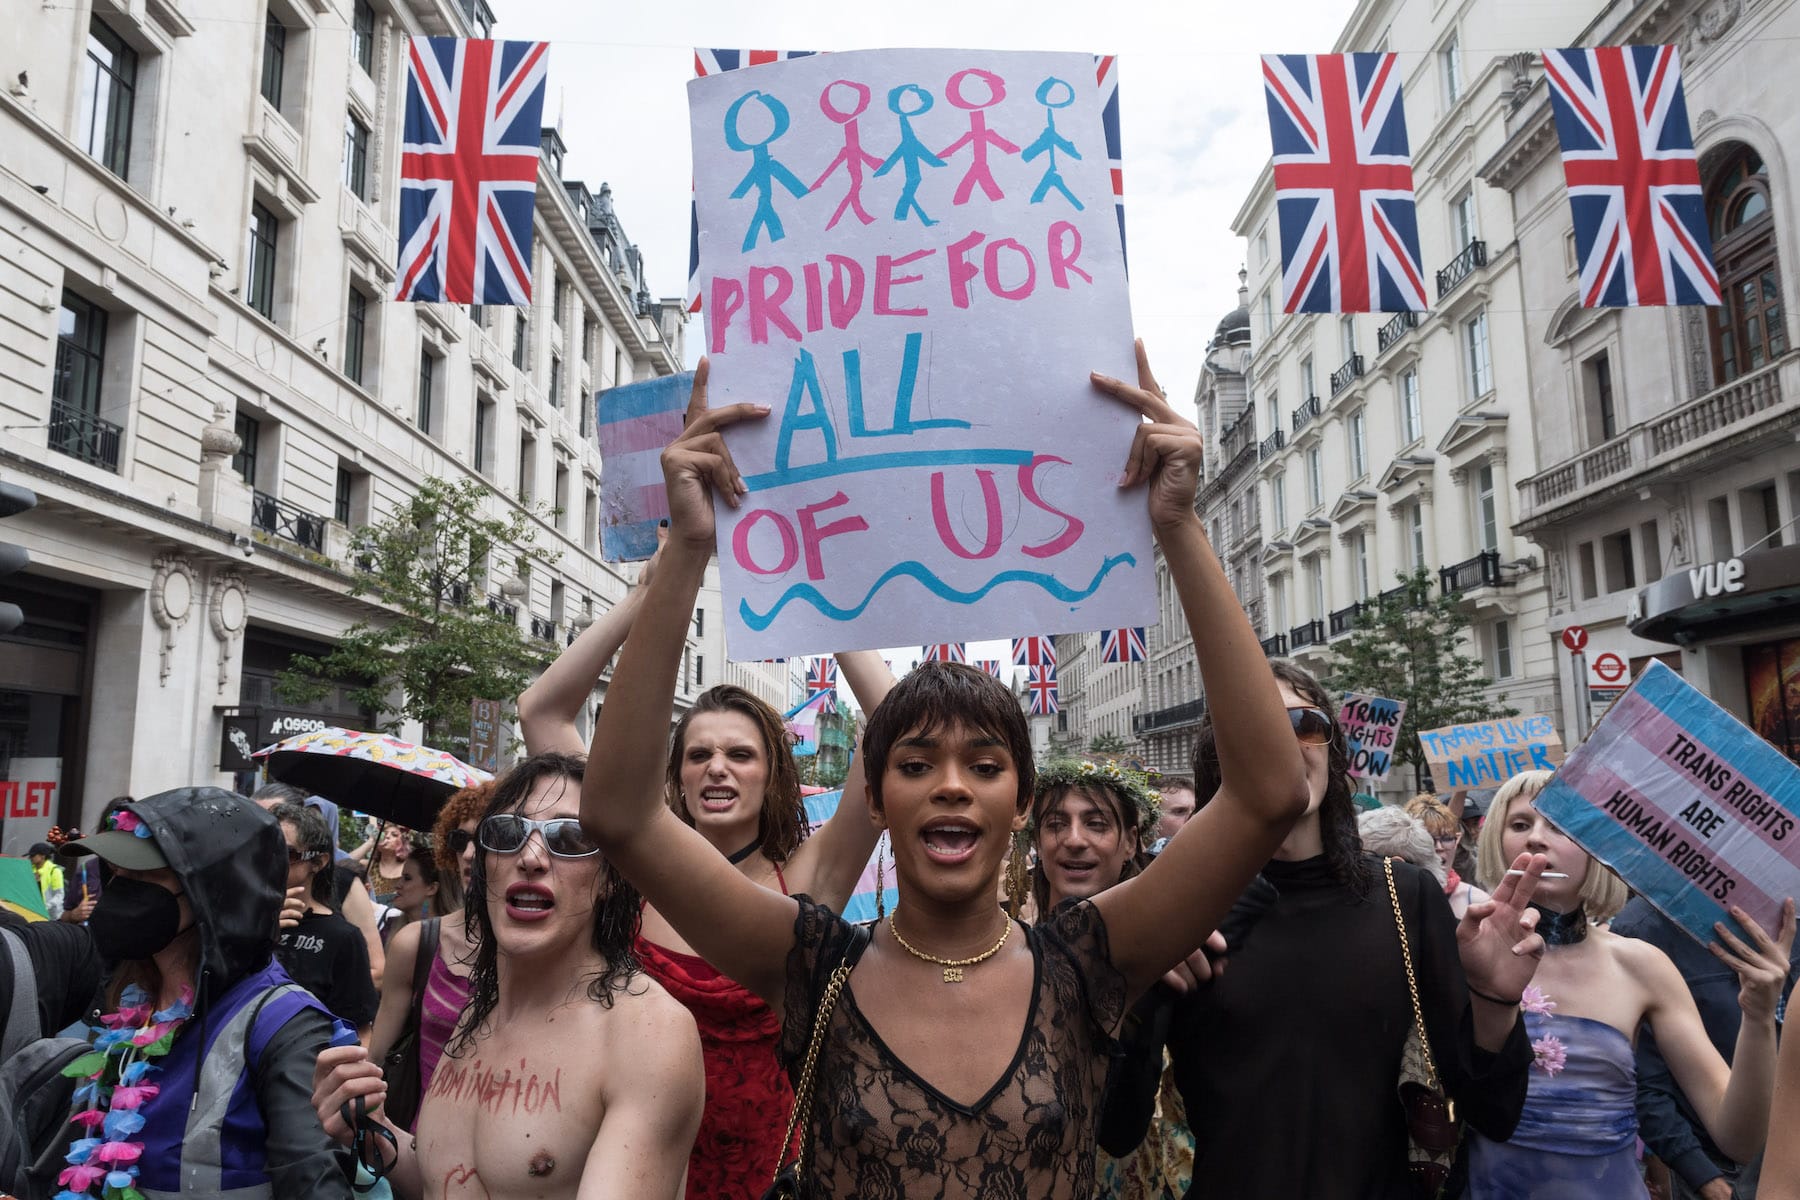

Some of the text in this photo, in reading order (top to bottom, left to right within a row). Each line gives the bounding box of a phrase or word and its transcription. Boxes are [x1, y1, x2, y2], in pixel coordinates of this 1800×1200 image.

[711, 221, 1093, 353] PRIDE FOR
[775, 333, 972, 472] ALL
[732, 454, 1085, 580] OF US
[1568, 630, 1582, 646] Y
[1345, 699, 1400, 726] TRANS
[1420, 716, 1553, 756] TRANS LIVES
[1447, 742, 1556, 786] MATTER
[1665, 733, 1794, 841] TRANS RIGHTS
[1603, 790, 1736, 905] HUMAN RIGHTS.
[1679, 800, 1725, 840] ARE
